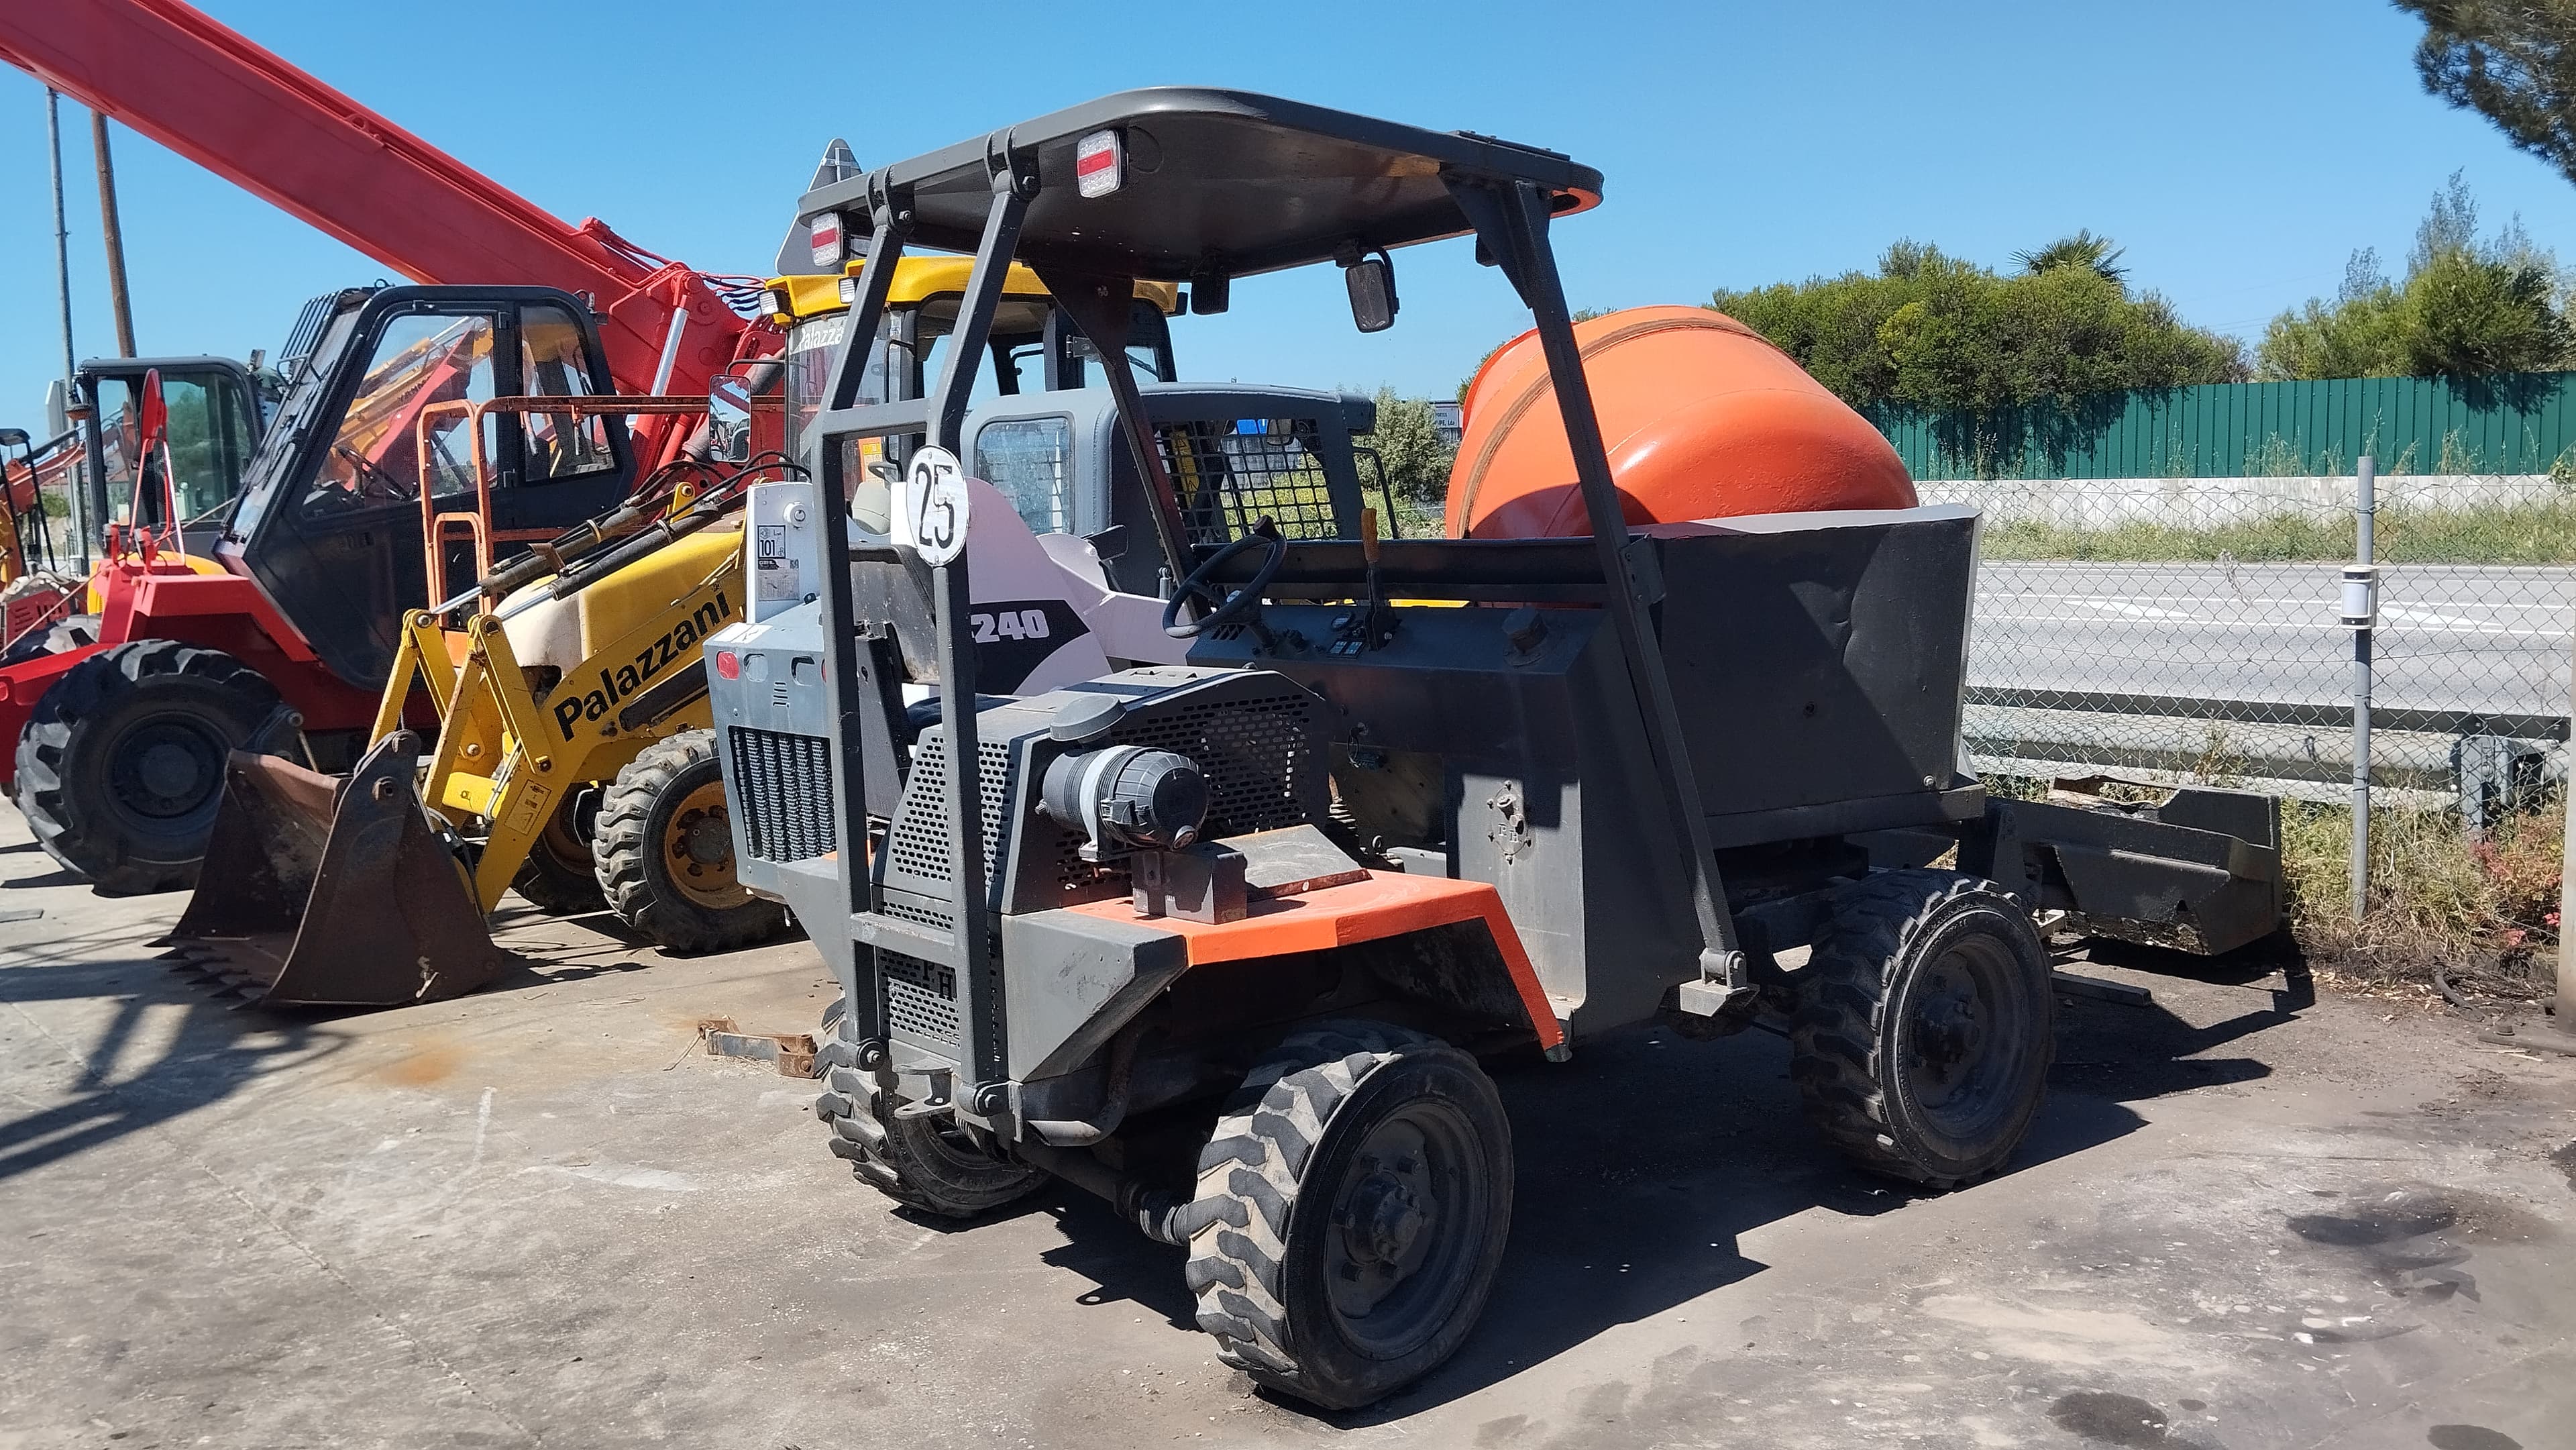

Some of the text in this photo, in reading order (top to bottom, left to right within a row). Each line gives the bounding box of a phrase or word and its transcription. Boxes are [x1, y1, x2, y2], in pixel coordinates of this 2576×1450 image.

[760, 539, 775, 556] 101
[915, 462, 955, 549] 25
[553, 582, 731, 742] Palazzani
